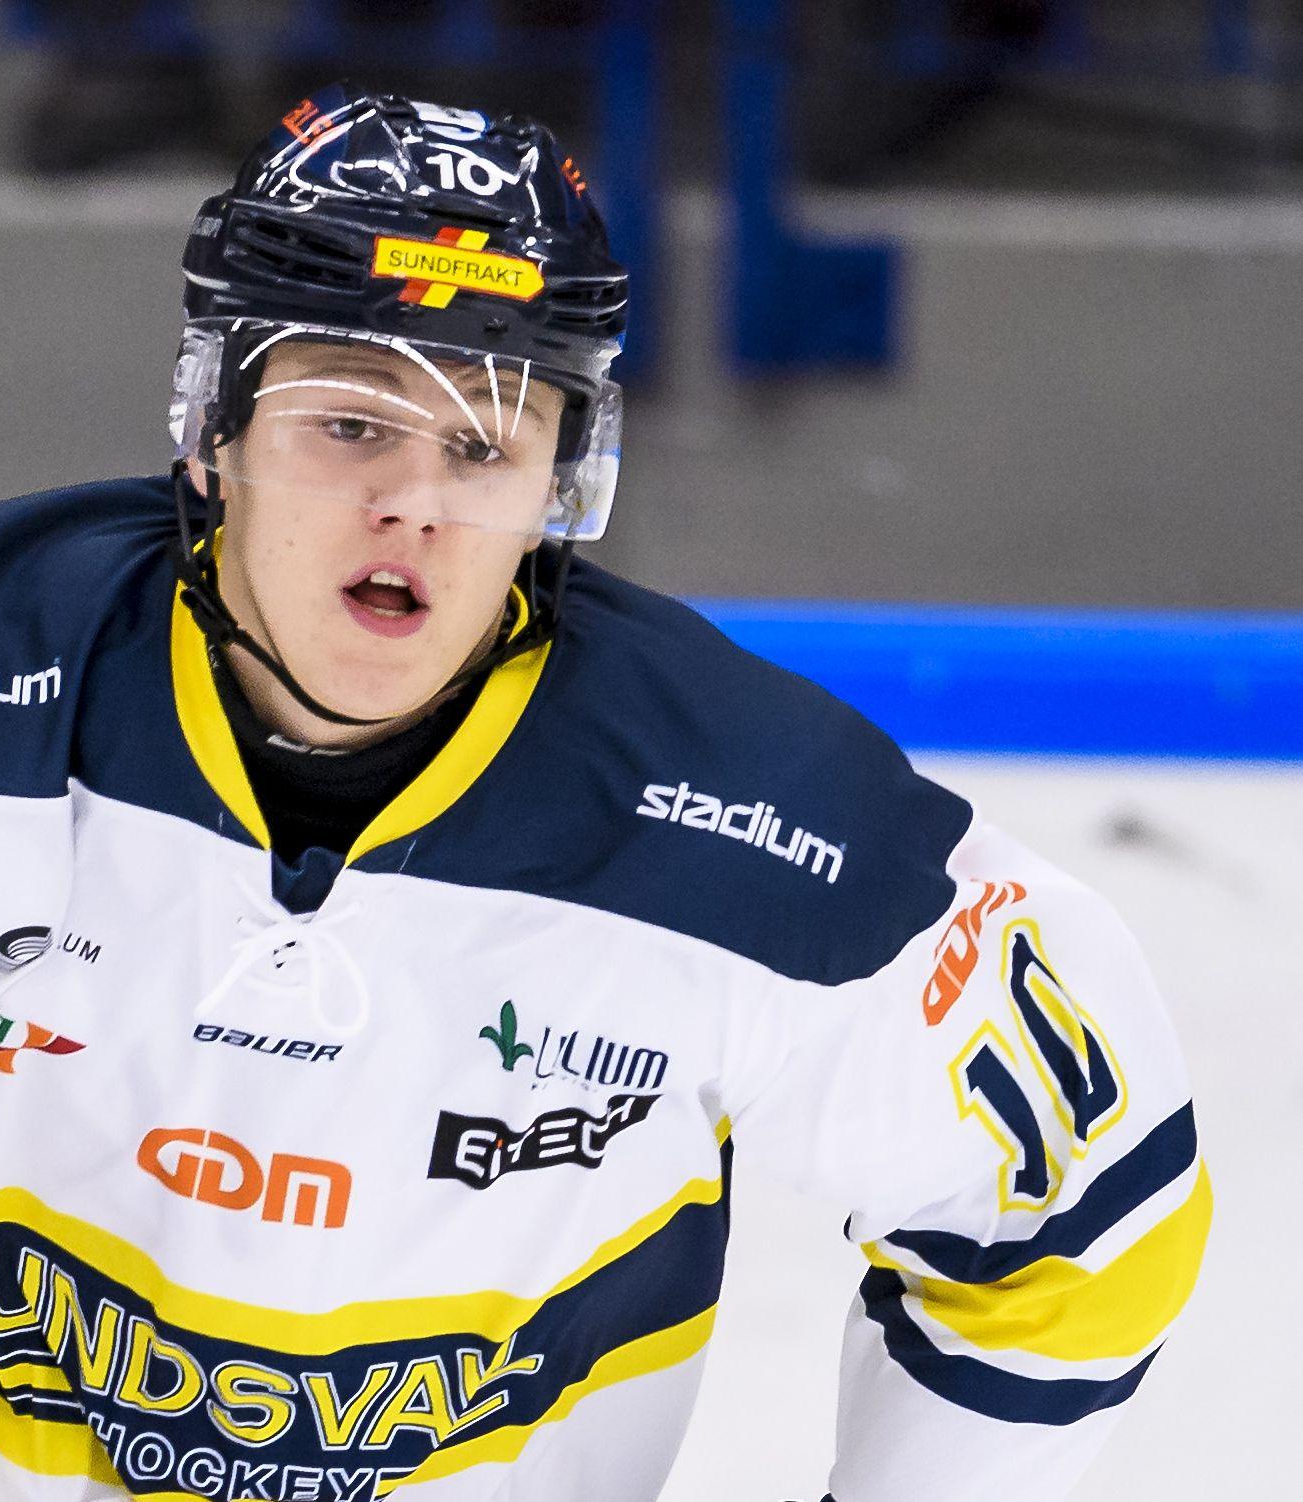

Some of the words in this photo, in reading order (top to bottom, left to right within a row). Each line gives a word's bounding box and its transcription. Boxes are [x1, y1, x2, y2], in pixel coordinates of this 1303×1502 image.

[426, 152, 503, 196] 10
[388, 248, 524, 288] SUNDFRAKT
[636, 782, 847, 884] stadium
[56, 932, 102, 964] UM
[948, 918, 1129, 1214] 10
[137, 1127, 353, 1230] GDM
[88, 1410, 375, 1502] HOCKEY
